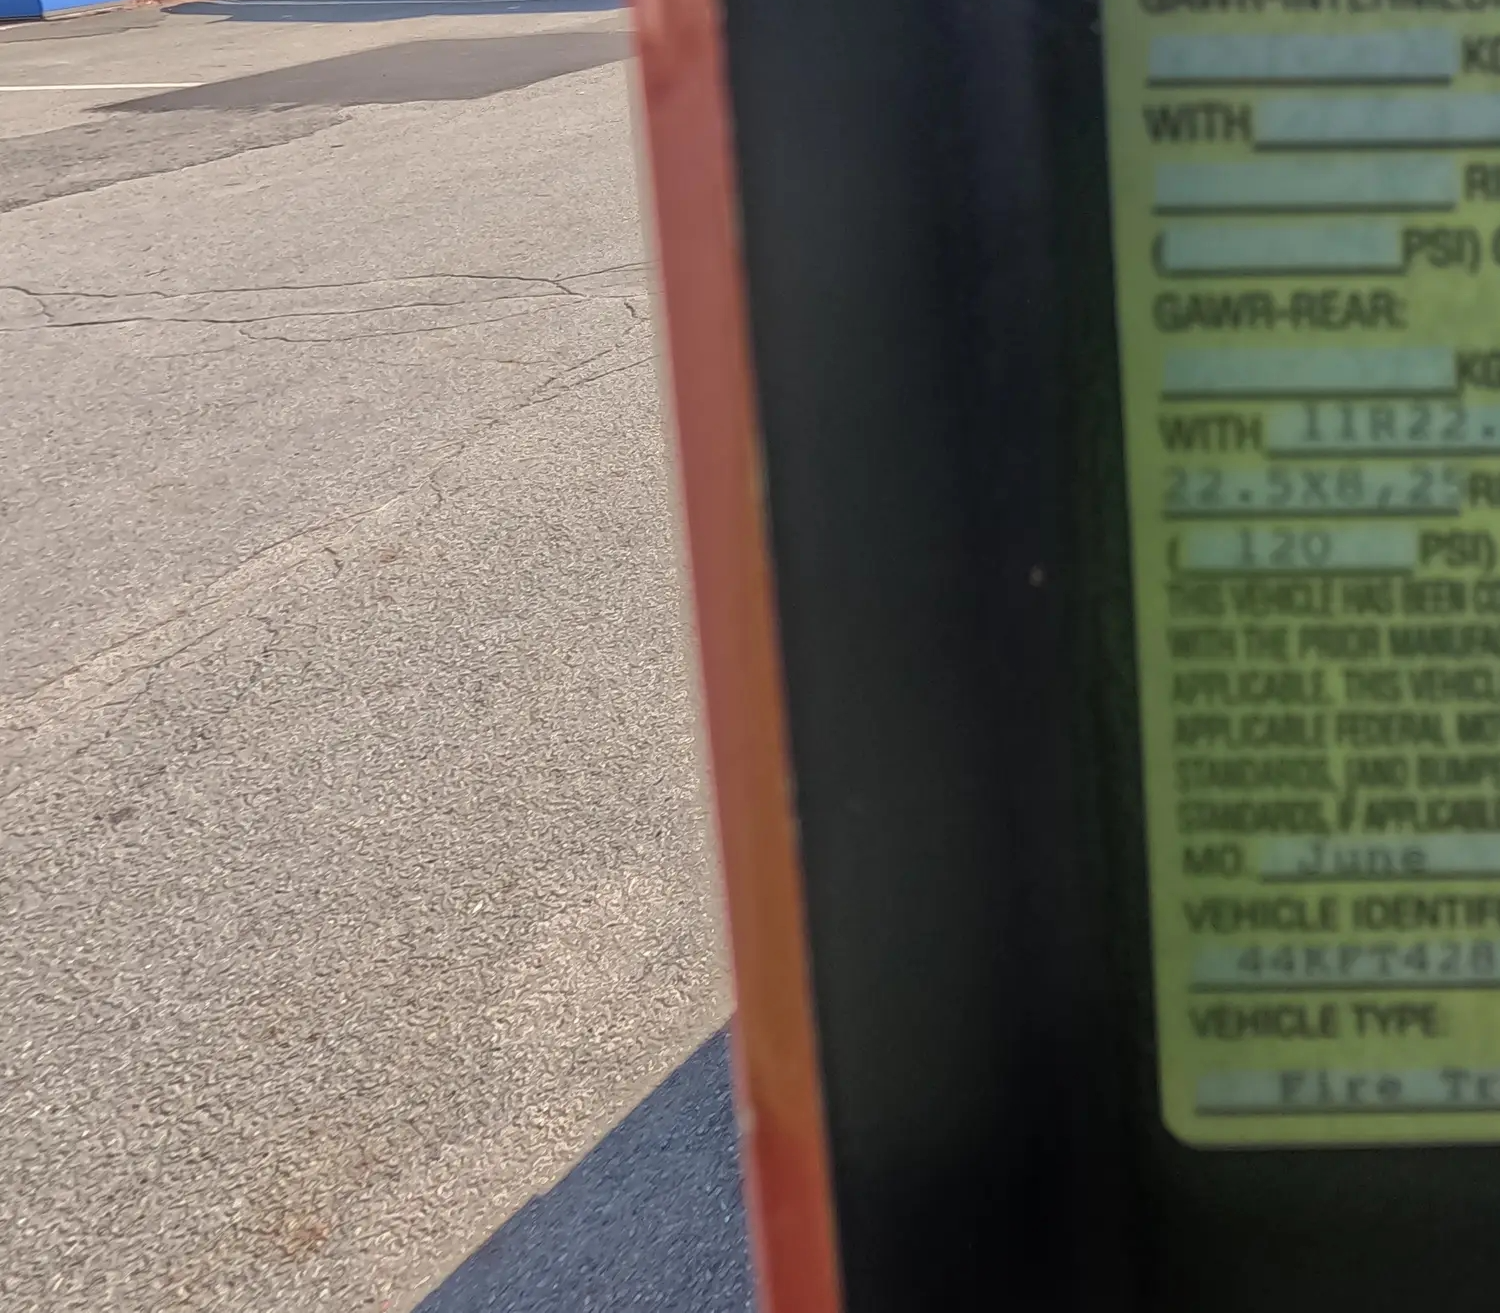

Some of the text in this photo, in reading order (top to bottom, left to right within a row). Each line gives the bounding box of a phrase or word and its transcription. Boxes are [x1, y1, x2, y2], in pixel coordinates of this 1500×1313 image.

[1141, 100, 1254, 145] WITH
[1158, 411, 1265, 453] WITH
[1238, 528, 1332, 567] 120
[1298, 836, 1430, 877] June
[1183, 894, 1338, 934] VEHICLE
[1188, 1002, 1338, 1040] VEHICLE
[1279, 1067, 1404, 1104] Fire
